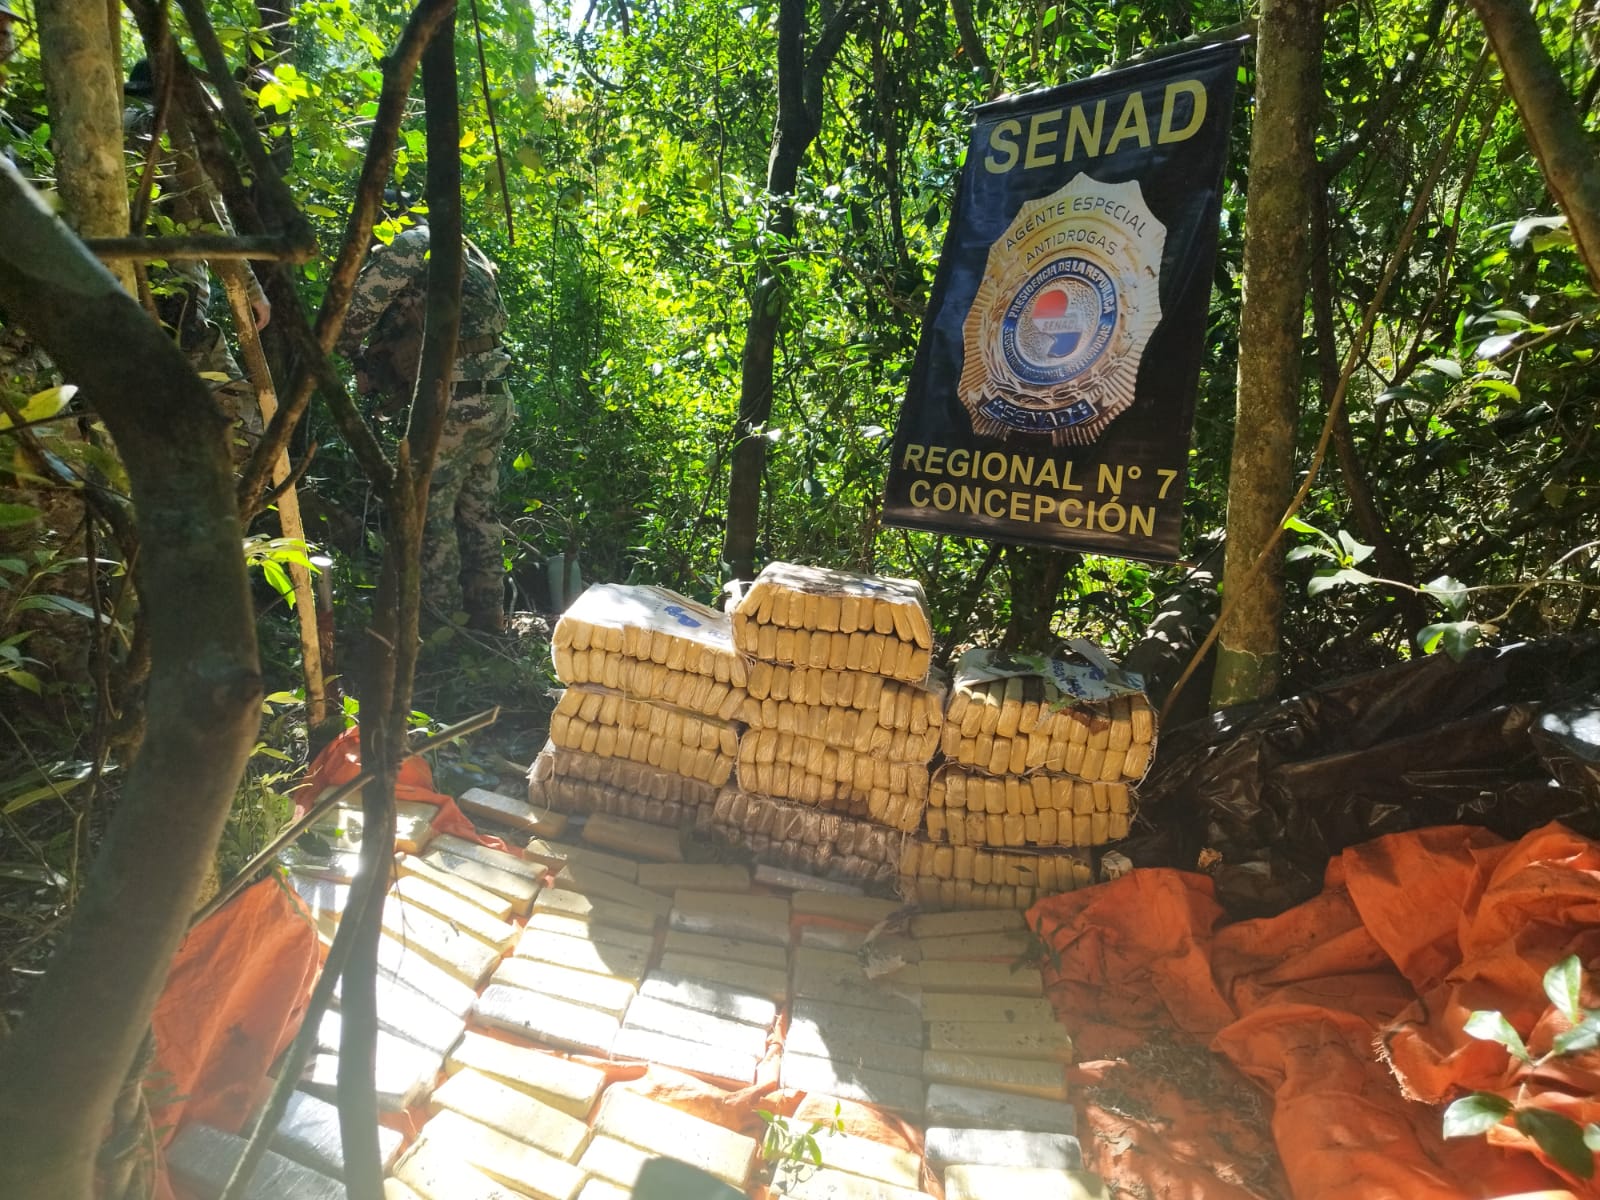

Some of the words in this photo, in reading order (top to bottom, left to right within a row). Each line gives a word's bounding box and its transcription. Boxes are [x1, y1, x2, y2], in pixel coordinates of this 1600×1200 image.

[984, 79, 1208, 174] SENAD
[1006, 203, 1066, 252] AGENTE
[1073, 197, 1146, 238] ESPECIAL
[1026, 229, 1117, 264] ANTIDROGAS
[1007, 265, 1057, 318] PRESIDENCIA
[1058, 261, 1071, 272] DE
[1072, 260, 1085, 273] LA
[1000, 404, 1073, 427] SENAD
[903, 444, 1083, 491] REGIONAL
[1097, 463, 1142, 495] N°
[1157, 469, 1178, 499] 7
[909, 480, 1156, 537] CONCEPCIÓN
